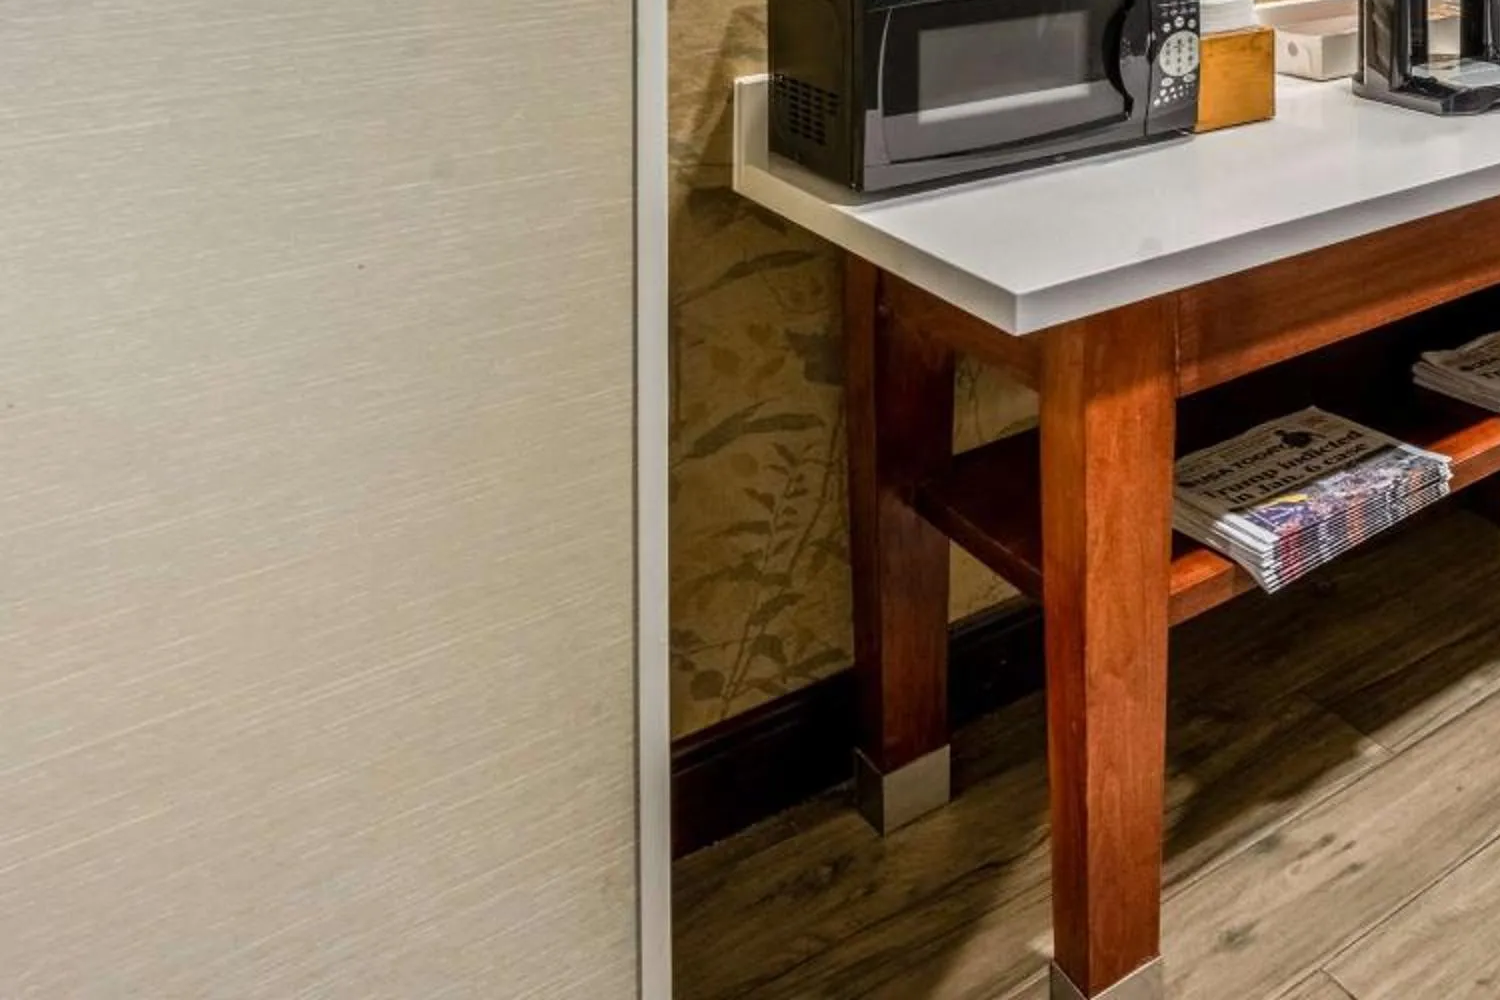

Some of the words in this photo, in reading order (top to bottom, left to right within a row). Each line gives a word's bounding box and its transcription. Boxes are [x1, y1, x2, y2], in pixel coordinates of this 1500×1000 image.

[1203, 468, 1279, 499] Trump
[1277, 429, 1365, 470] indicted
[1227, 491, 1256, 504] in
